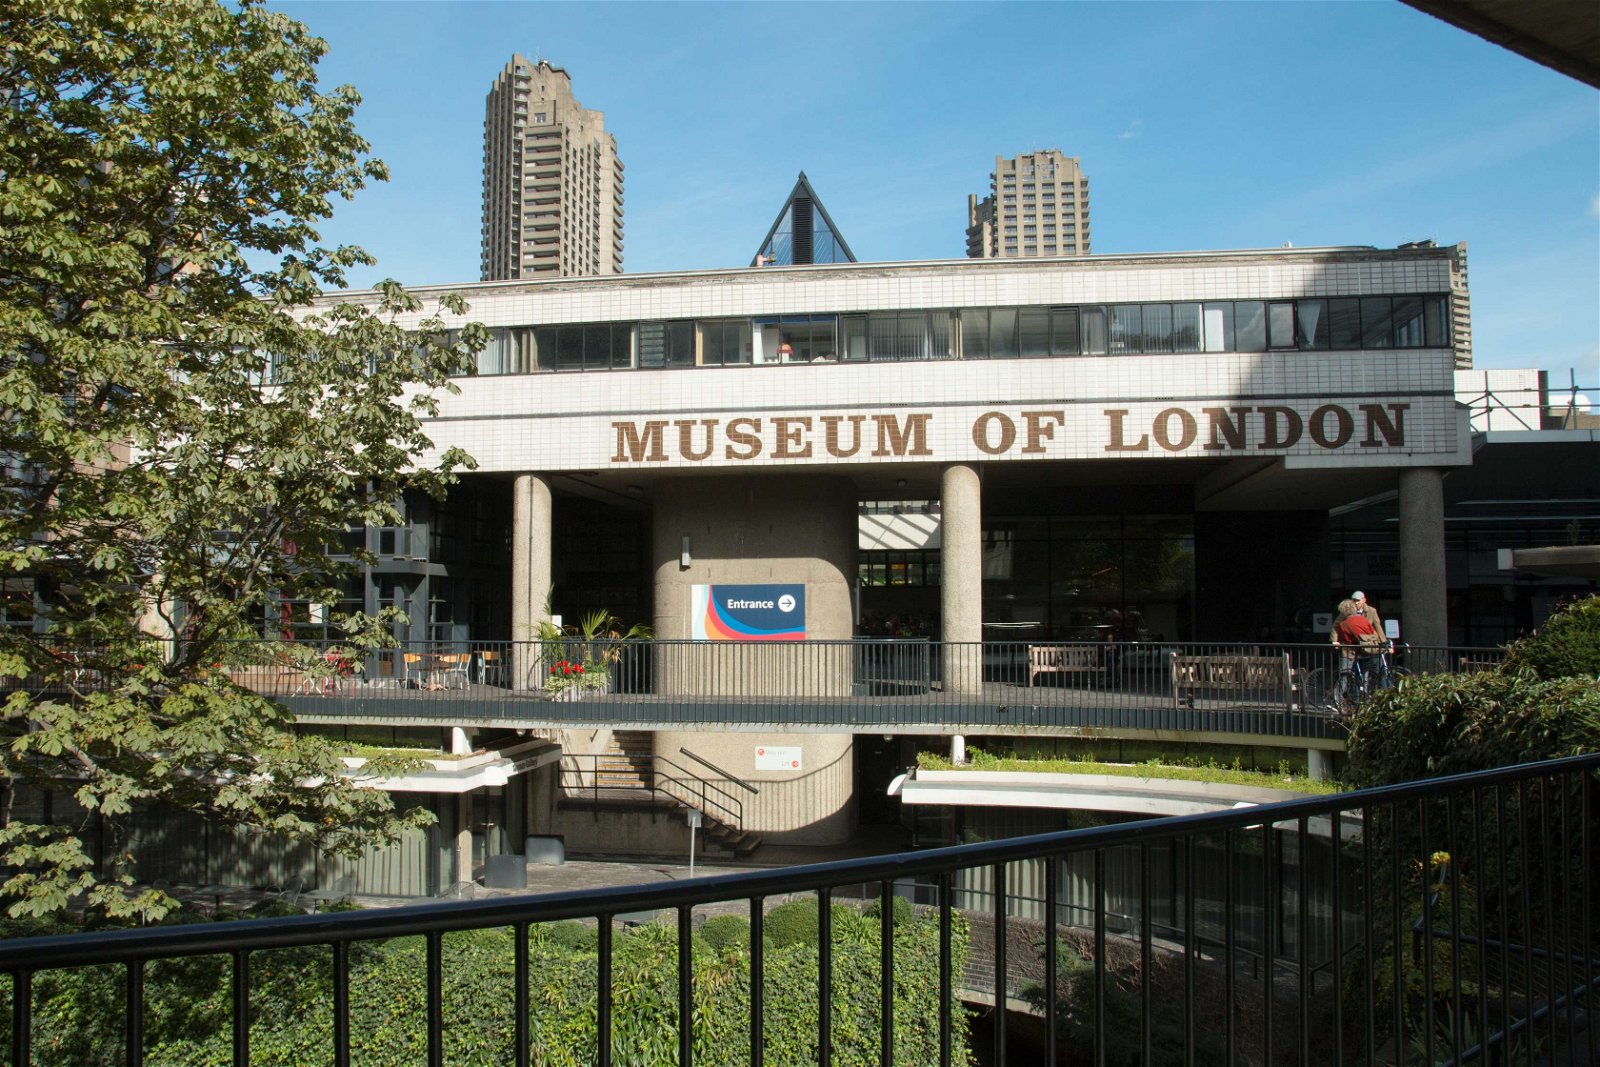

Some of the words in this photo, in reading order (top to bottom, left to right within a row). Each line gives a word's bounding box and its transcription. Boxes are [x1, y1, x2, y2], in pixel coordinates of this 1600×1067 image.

[611, 413, 933, 463] MUSEUM
[972, 410, 1065, 455] OF
[1104, 403, 1410, 453] LONDON
[727, 599, 774, 609] Entrance
